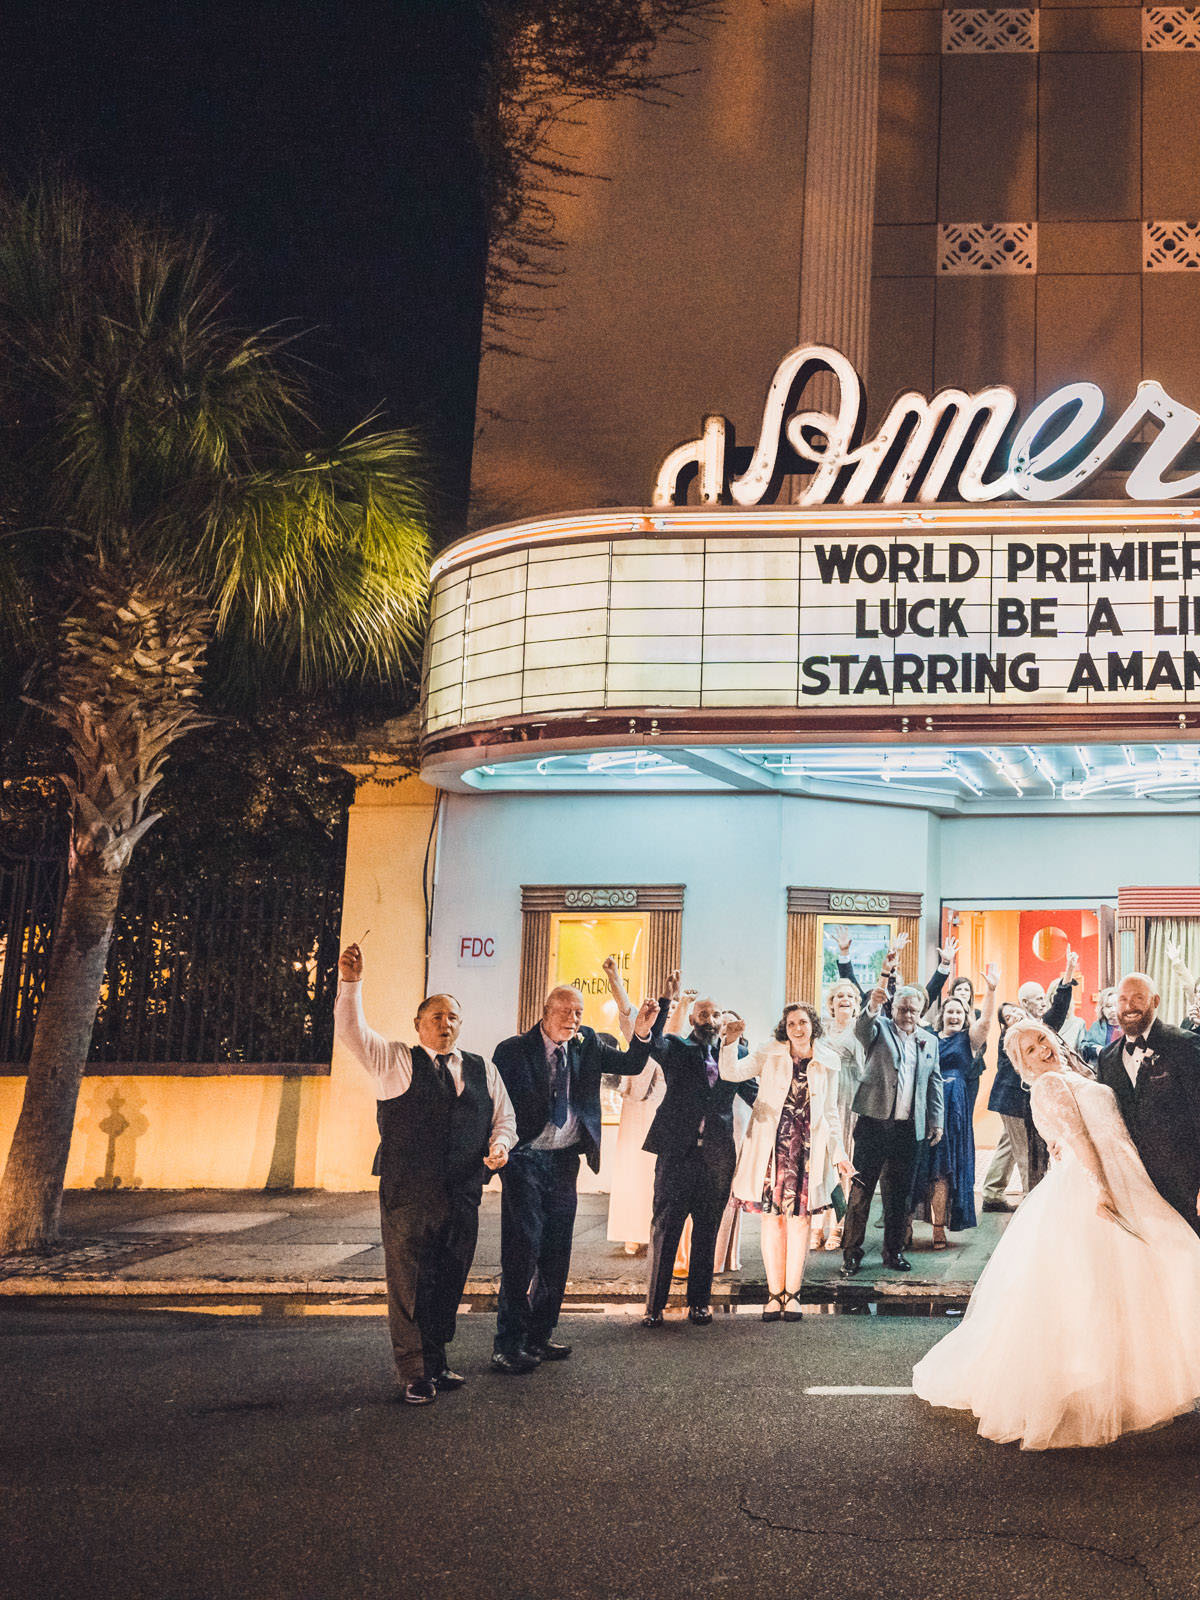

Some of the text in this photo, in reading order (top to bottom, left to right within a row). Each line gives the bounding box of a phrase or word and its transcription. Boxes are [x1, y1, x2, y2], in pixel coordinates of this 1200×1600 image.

[814, 542, 981, 585] WORLD
[855, 597, 968, 640] LUCK
[998, 597, 1059, 639] BE
[1086, 597, 1123, 638] A
[801, 652, 1041, 697] STARRING
[460, 937, 495, 958] FDC
[571, 977, 630, 995] AMERICN
